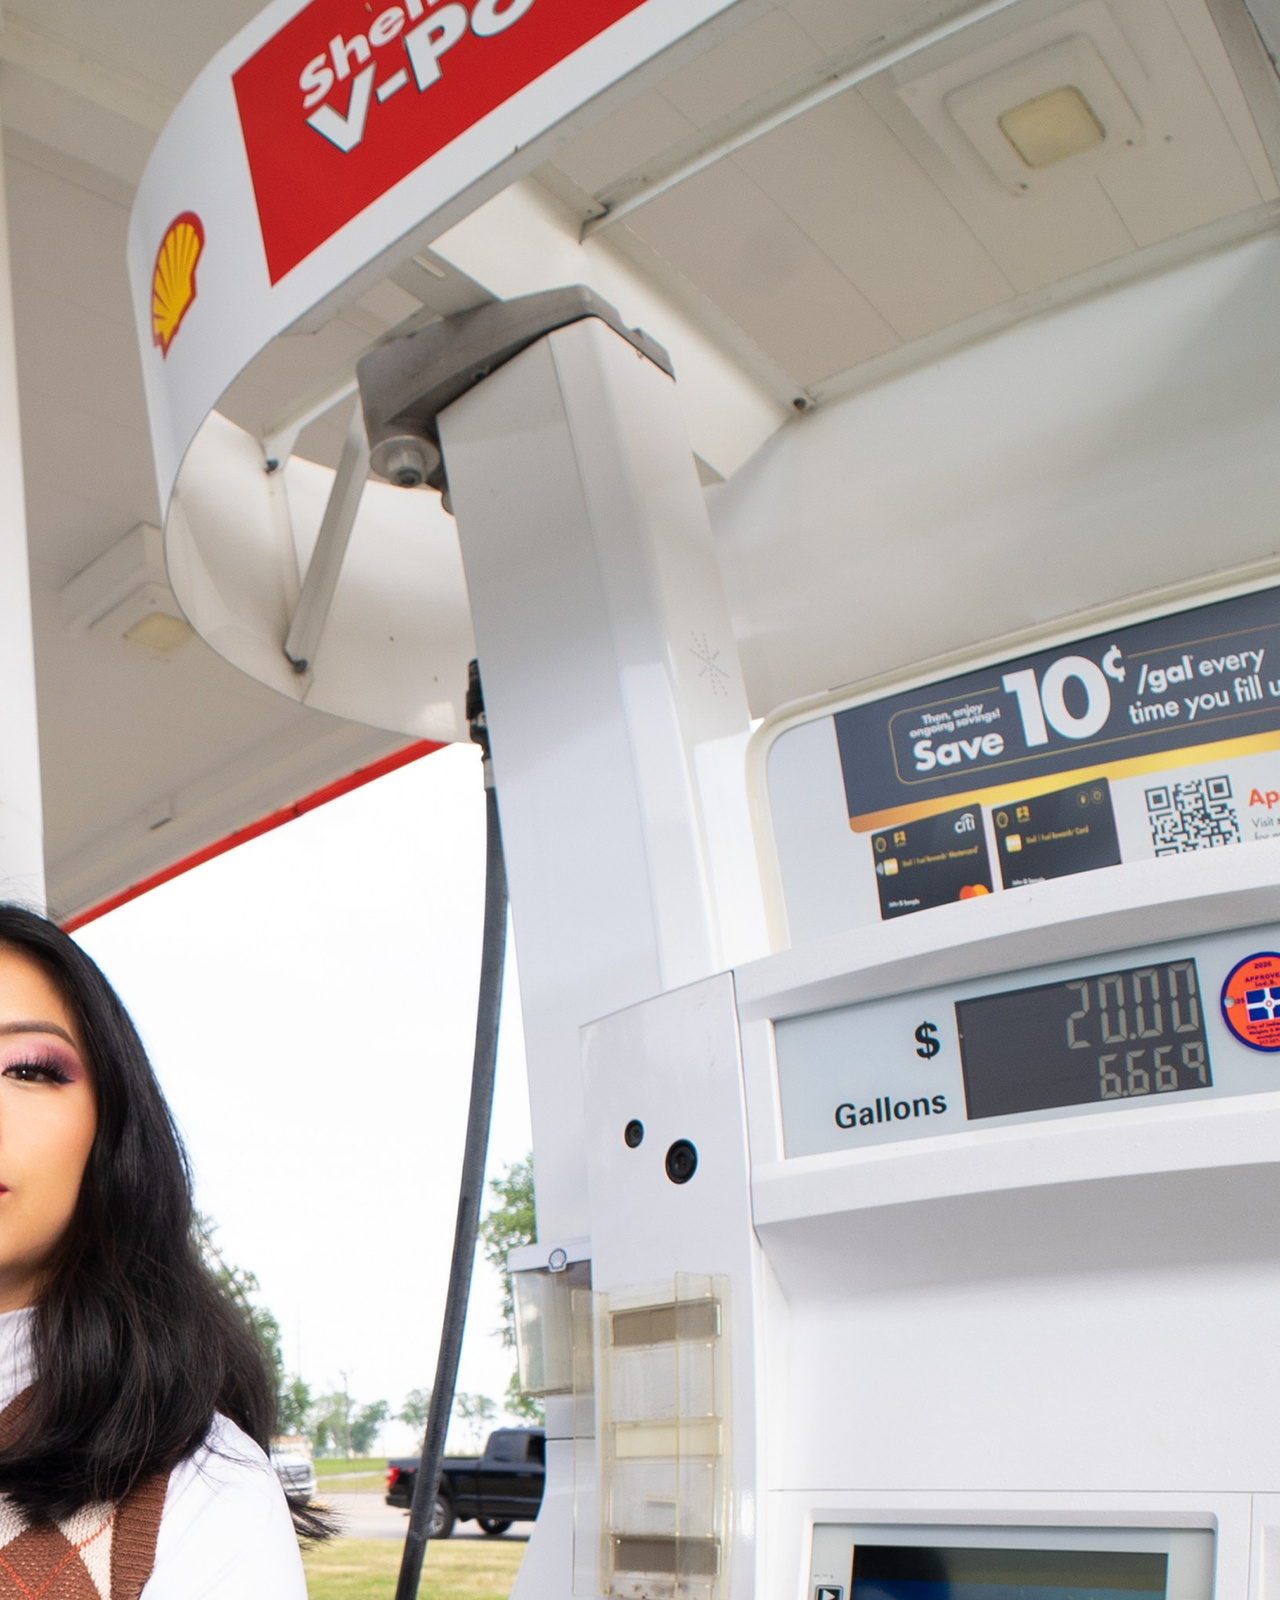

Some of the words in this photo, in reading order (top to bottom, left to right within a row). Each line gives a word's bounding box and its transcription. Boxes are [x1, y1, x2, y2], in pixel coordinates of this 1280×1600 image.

[1198, 648, 1265, 677] every
[922, 711, 951, 725] Then,
[952, 704, 983, 718] enjoy
[1128, 700, 1180, 725] time
[1184, 690, 1230, 720] you
[1234, 673, 1263, 703] fill
[909, 721, 955, 739] ongoing
[956, 708, 1001, 728] savings!
[913, 733, 1005, 771] Save
[954, 812, 976, 835] citi
[1066, 962, 1199, 1049] 20.00
[914, 1020, 941, 1060] $
[1099, 1041, 1207, 1099] 6.669
[835, 1094, 948, 1129] Gallons
